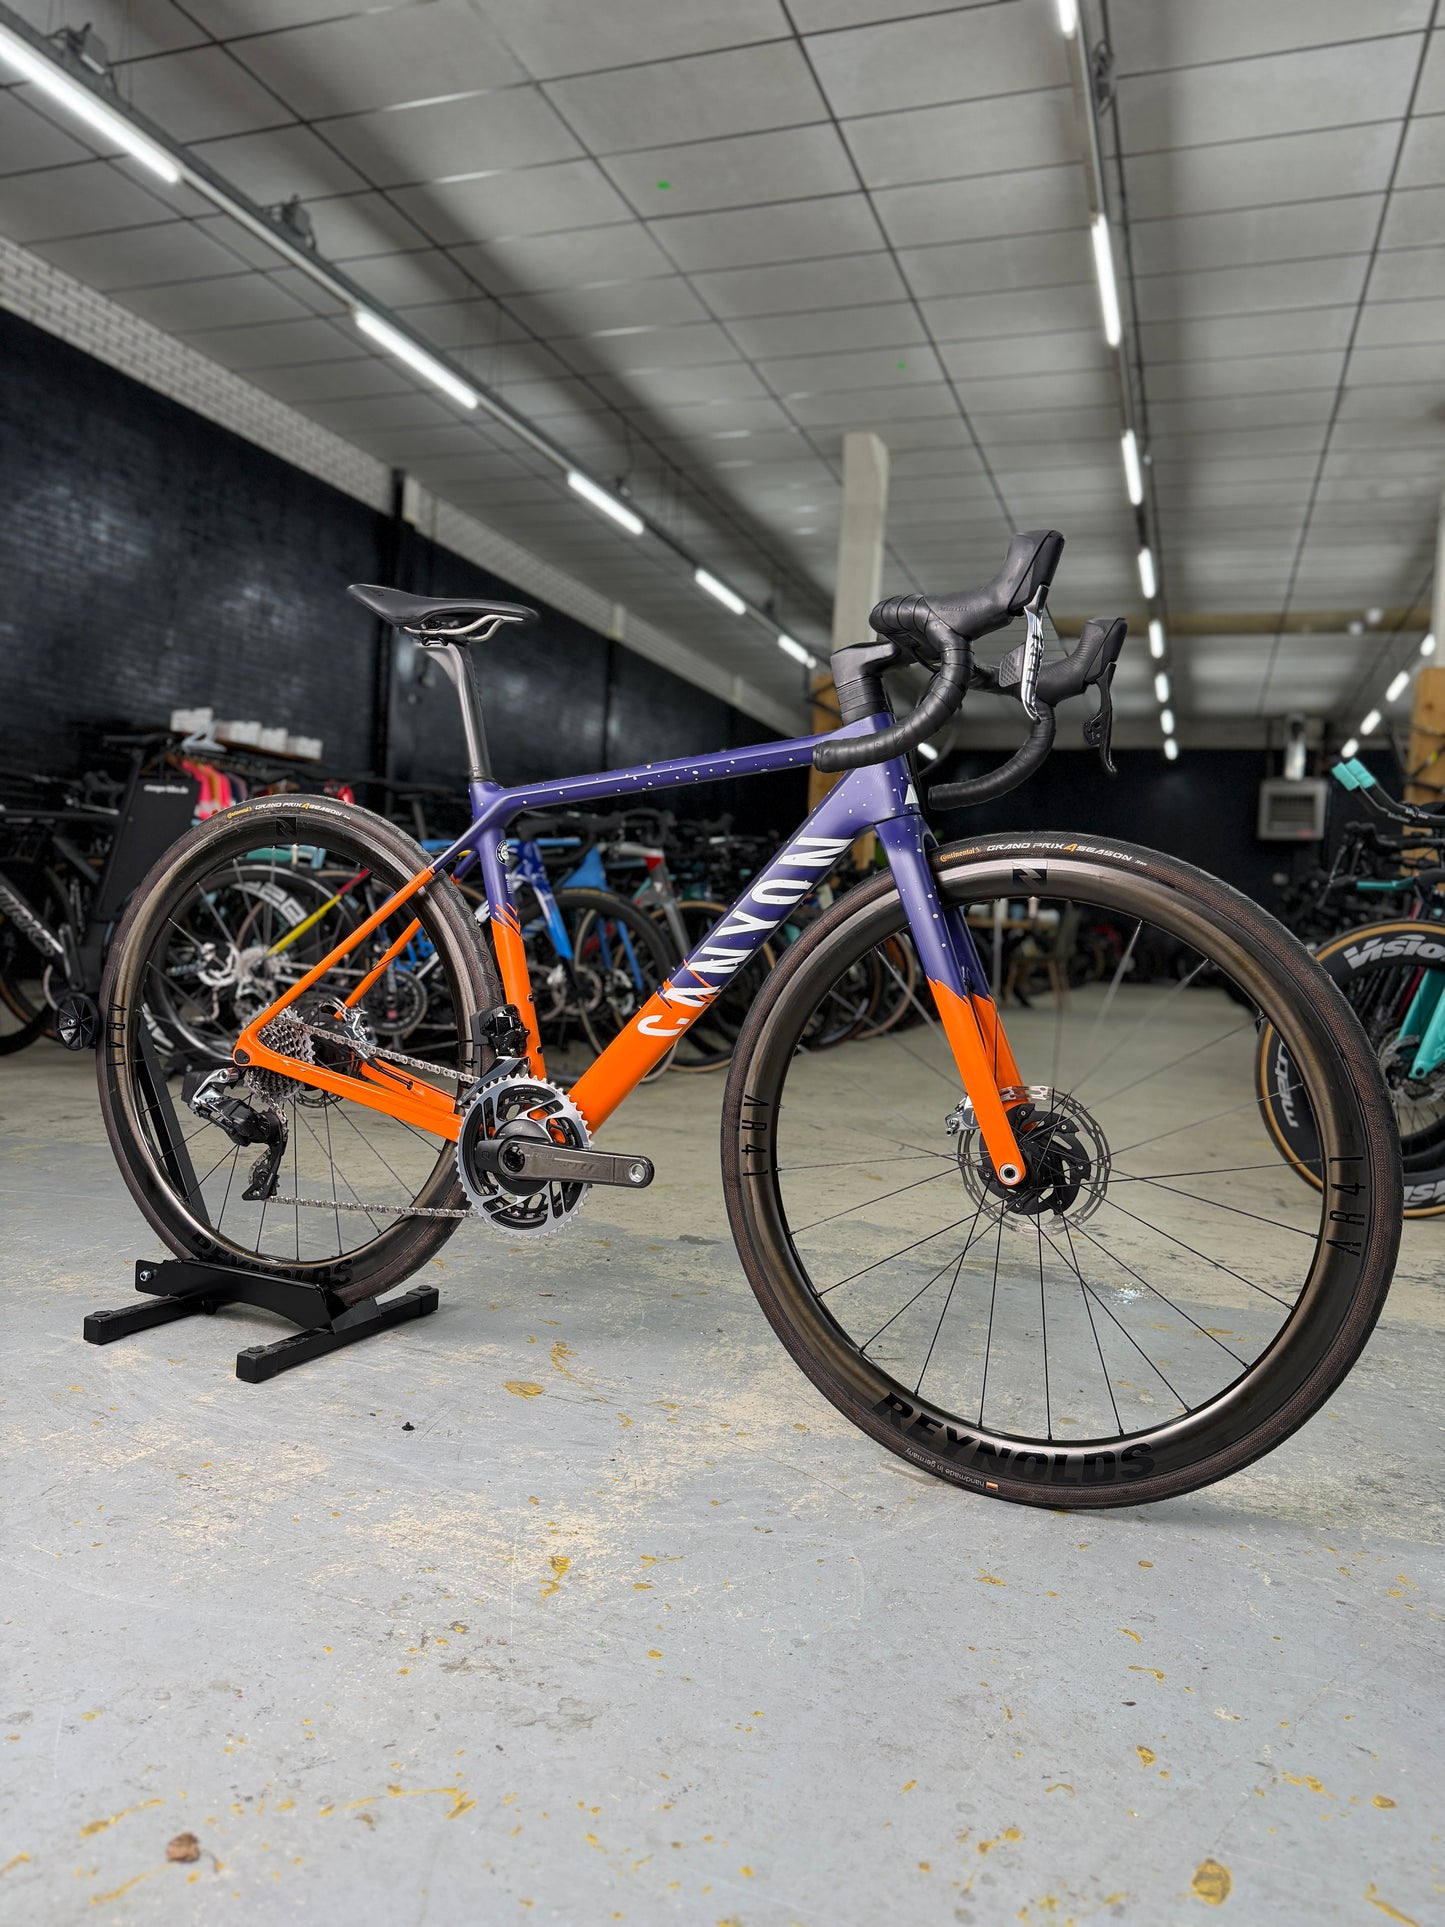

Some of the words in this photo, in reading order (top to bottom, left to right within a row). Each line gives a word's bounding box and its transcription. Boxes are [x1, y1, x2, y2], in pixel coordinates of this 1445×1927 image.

[255, 802, 281, 811] GRAND
[939, 848, 976, 863] Continental
[986, 842, 1031, 852] GRAND
[1032, 842, 1065, 850] PRIX
[637, 837, 855, 1037] CANYON
[1343, 933, 1445, 970] Visio
[738, 1094, 770, 1178] AR41
[1325, 1154, 1368, 1258] AR41
[872, 1391, 1157, 1483] REYNOLDS
[904, 1447, 937, 1468] germany
[944, 1467, 985, 1489] handmade
